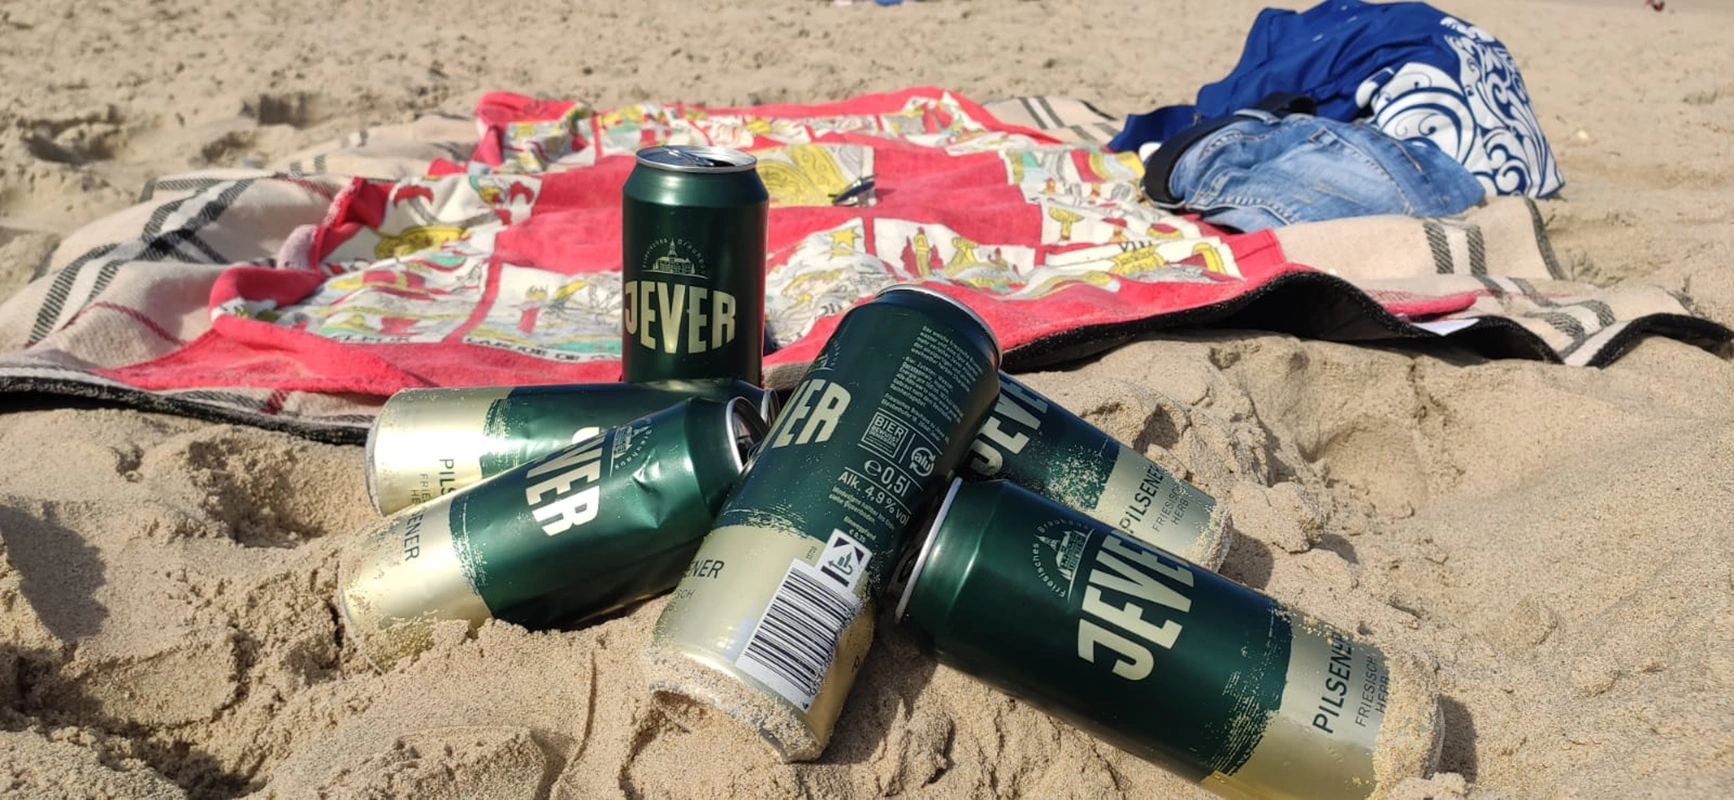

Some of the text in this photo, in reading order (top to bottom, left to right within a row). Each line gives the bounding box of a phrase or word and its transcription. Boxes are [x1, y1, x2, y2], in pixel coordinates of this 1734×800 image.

[625, 281, 736, 354] JEVER
[874, 416, 905, 438] BIER
[914, 453, 932, 471] alu
[838, 471, 861, 491] Alk.
[1032, 543, 1066, 597] Friesisches
